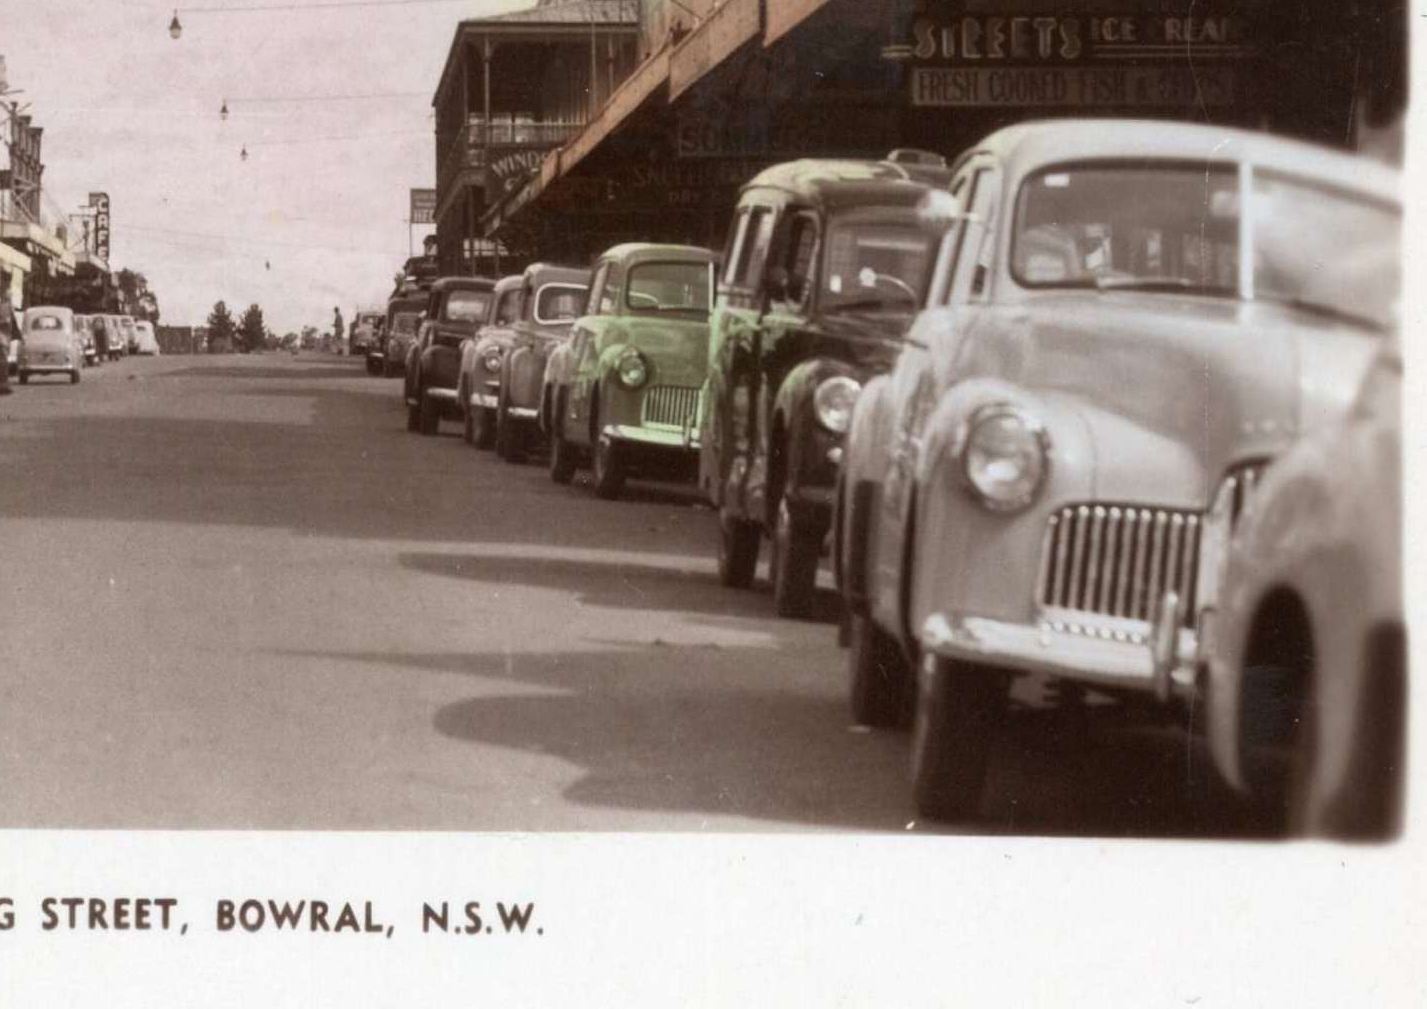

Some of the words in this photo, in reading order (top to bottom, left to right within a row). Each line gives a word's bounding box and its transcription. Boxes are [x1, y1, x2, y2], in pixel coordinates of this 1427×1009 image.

[912, 17, 1082, 60] STREETS
[1090, 17, 1137, 42] ICE
[920, 70, 980, 103] FRESH
